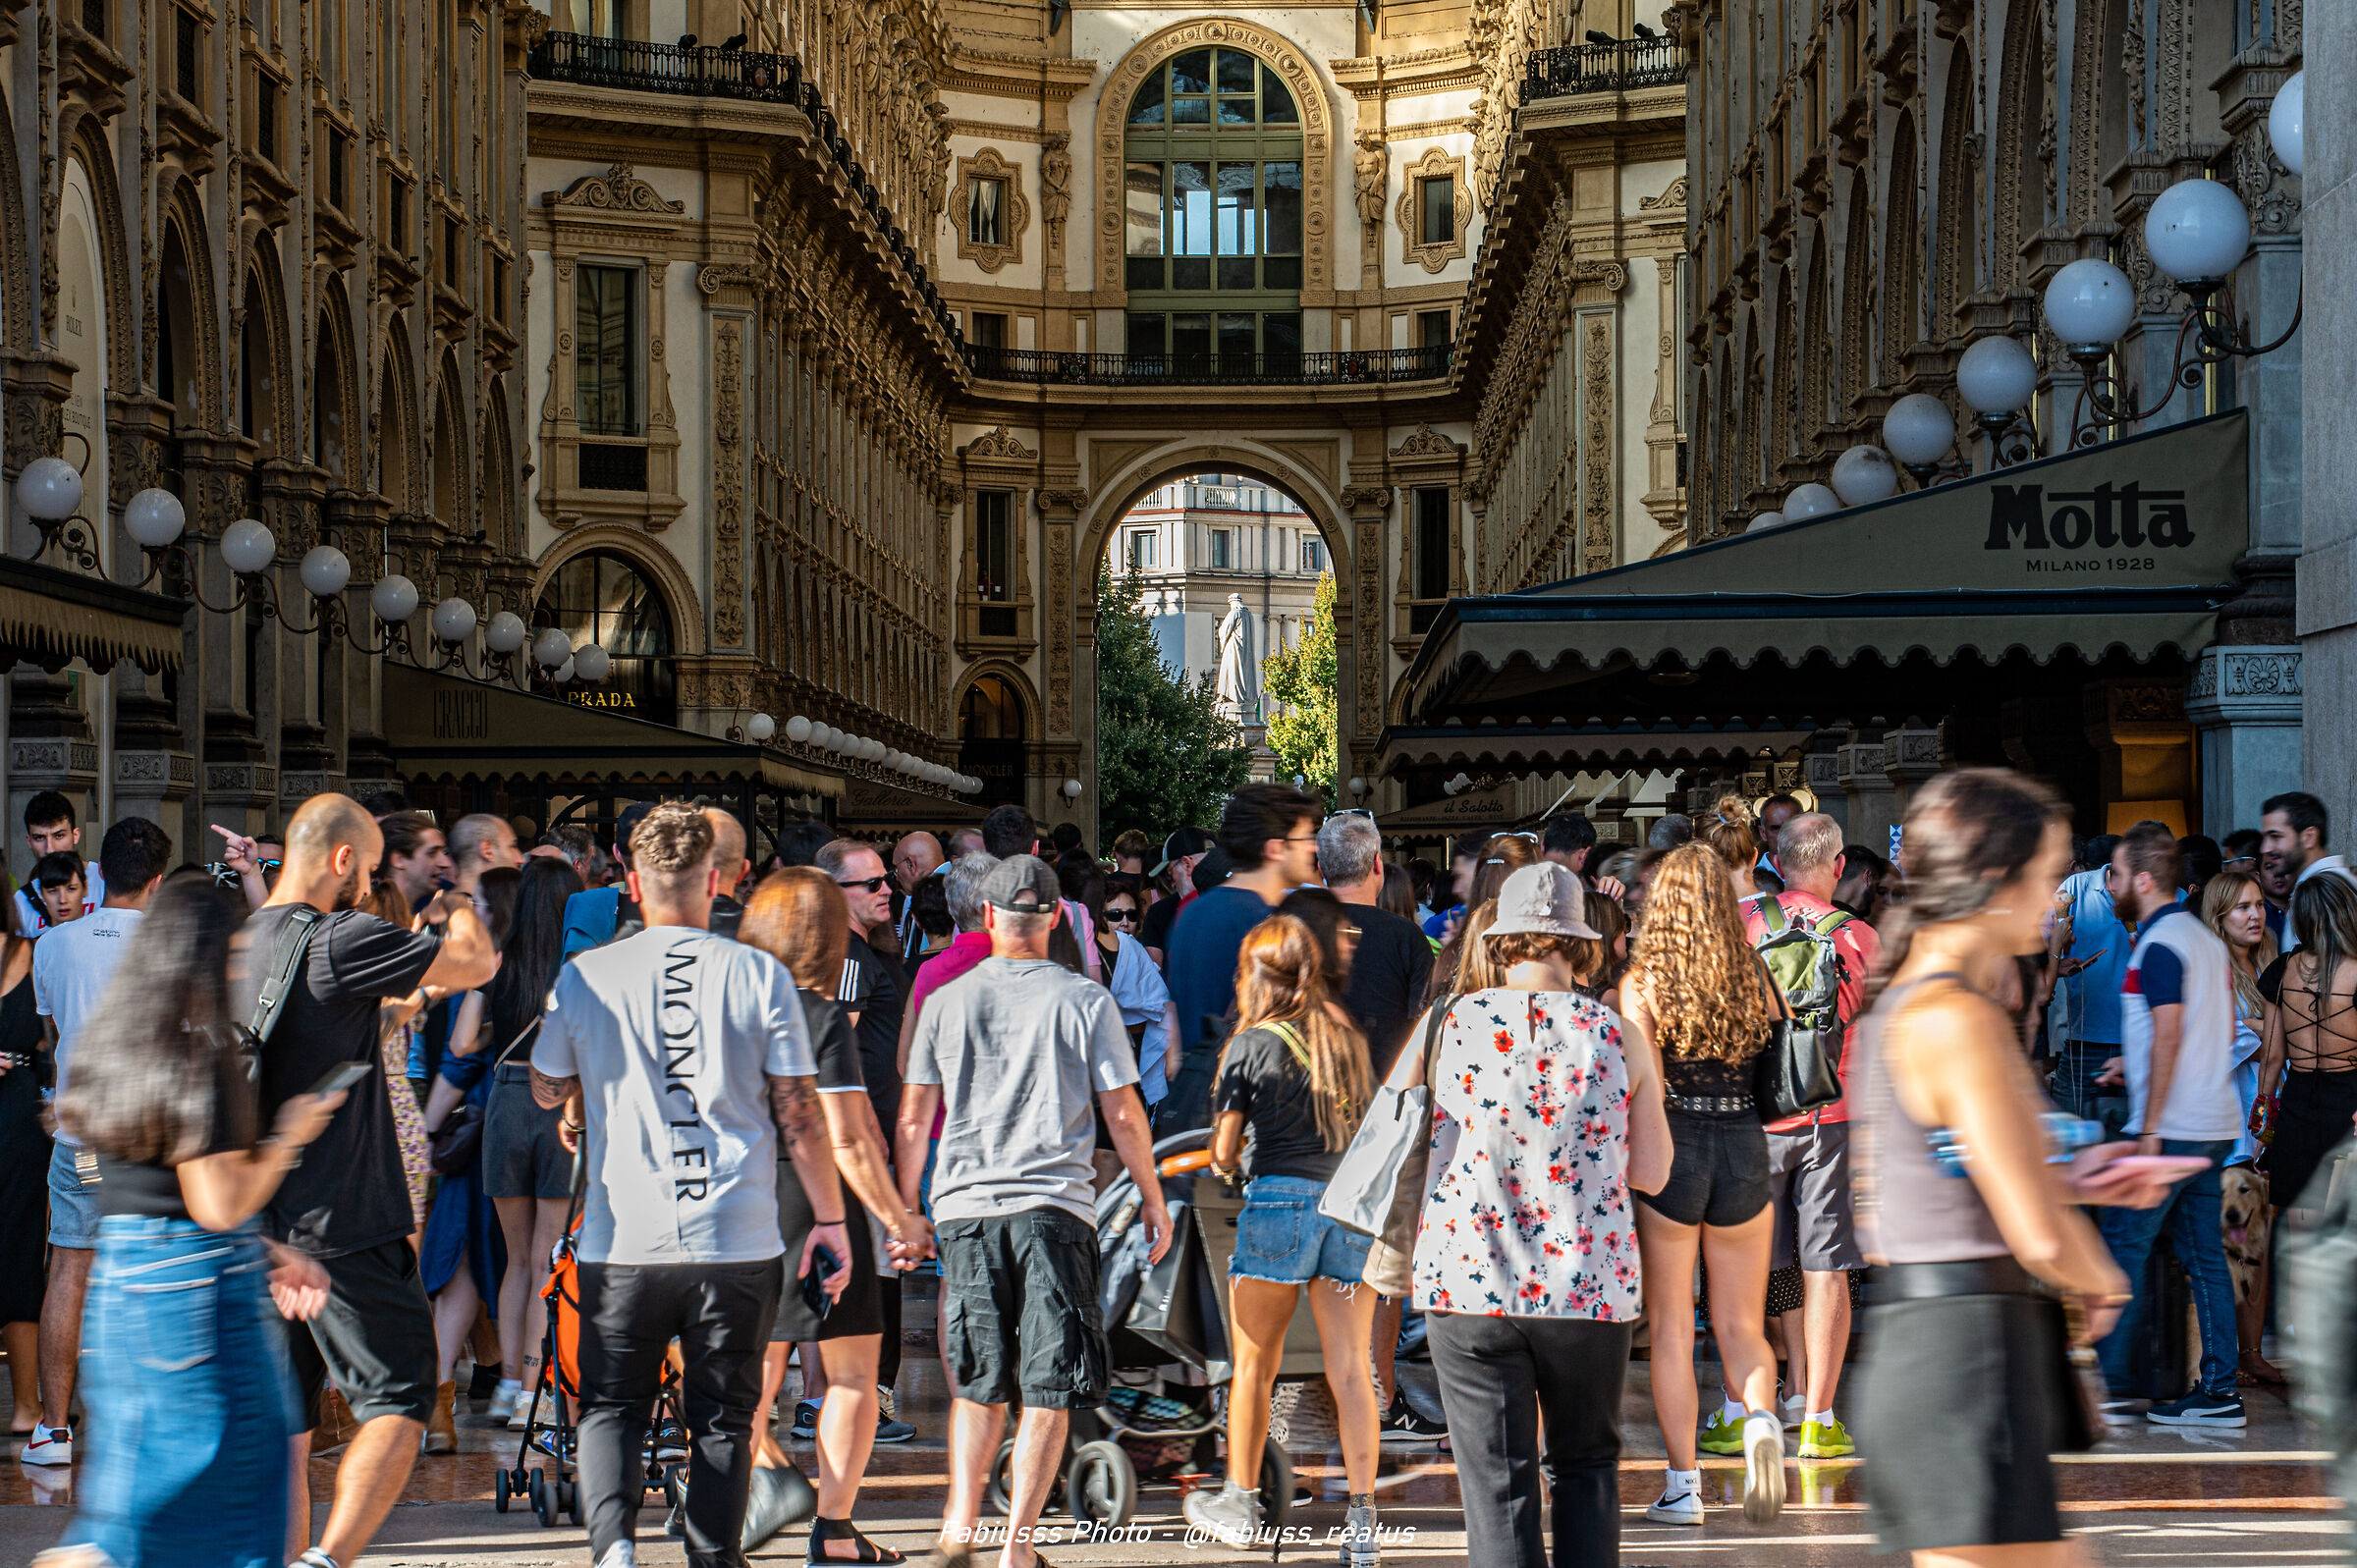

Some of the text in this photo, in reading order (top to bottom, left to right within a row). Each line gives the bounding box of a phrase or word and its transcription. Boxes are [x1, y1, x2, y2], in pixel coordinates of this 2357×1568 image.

[66, 314, 82, 337] ROLEX
[1984, 480, 2196, 550] Motta
[2026, 558, 2155, 572] MILANO 1928
[568, 691, 636, 707] PRADA
[433, 689, 487, 738] CRACCO
[962, 764, 1014, 777] MONCLER
[850, 787, 912, 806] Galleria
[1444, 798, 1505, 813] il Salotto
